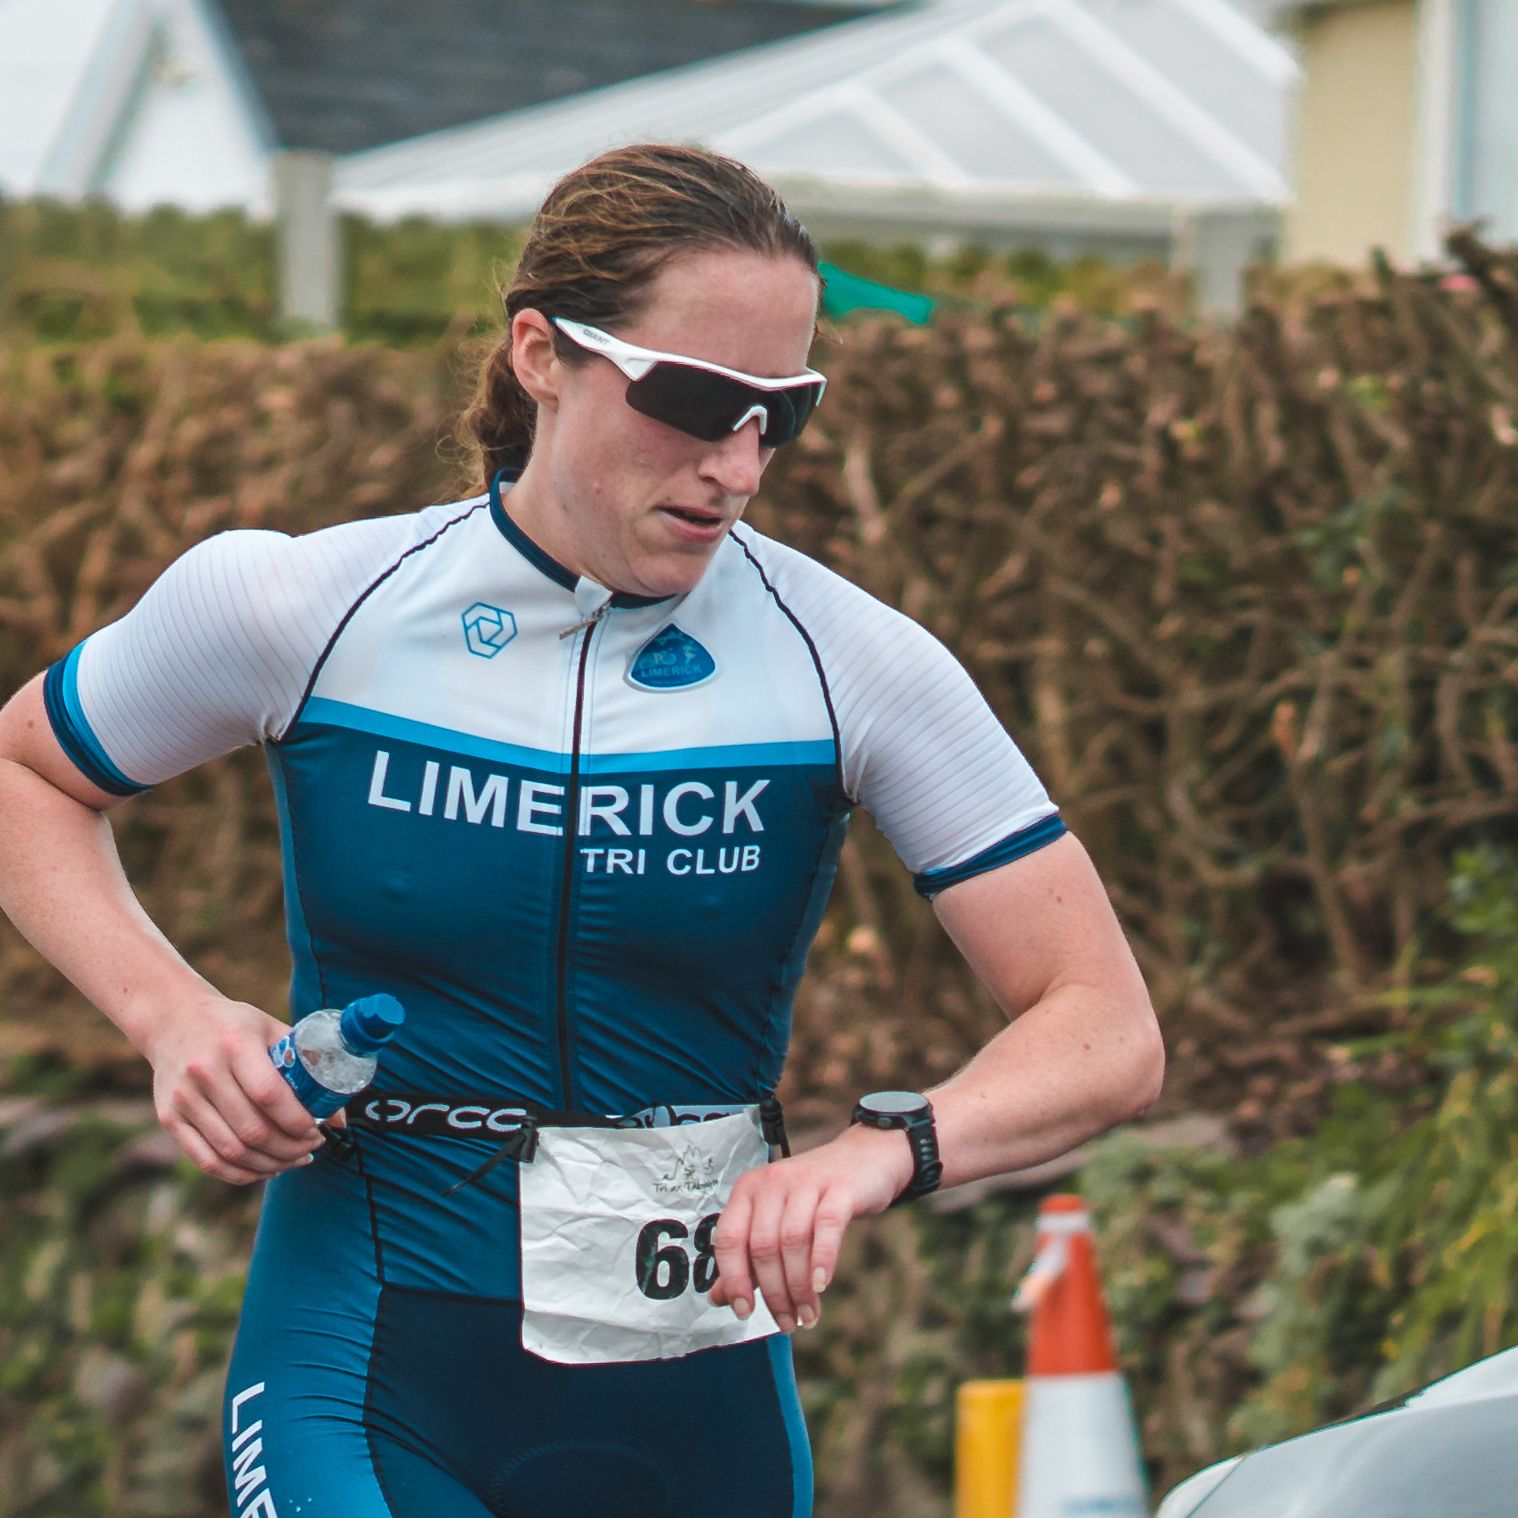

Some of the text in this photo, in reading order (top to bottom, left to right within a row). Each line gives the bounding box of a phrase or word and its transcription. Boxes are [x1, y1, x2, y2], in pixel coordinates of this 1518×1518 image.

[641, 663, 702, 678] LIMERICK
[367, 749, 771, 837] LIMERICK
[580, 845, 761, 875] TRI CLUB
